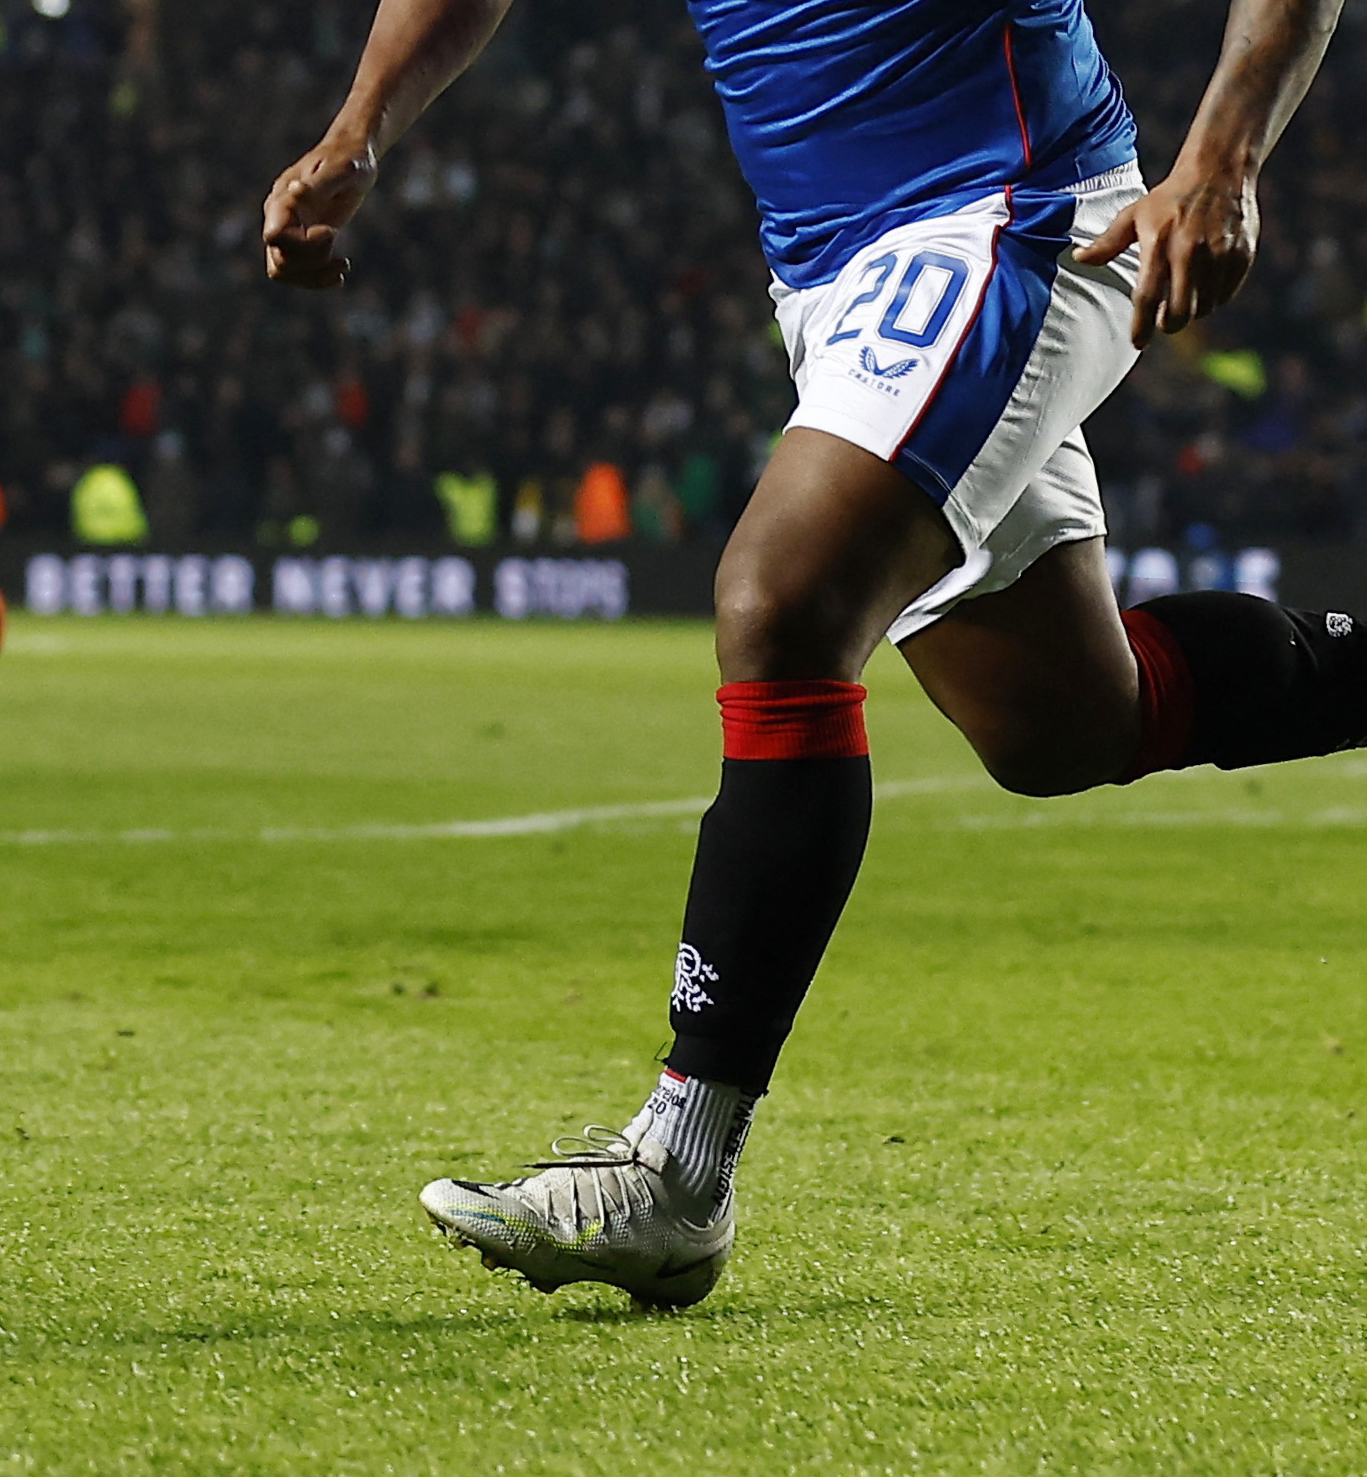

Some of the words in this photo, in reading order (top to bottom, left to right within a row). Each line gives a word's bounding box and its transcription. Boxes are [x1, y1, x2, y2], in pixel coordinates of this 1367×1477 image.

[827, 249, 972, 350] 20
[27, 554, 254, 616] BETTER
[273, 556, 475, 617] NEVER
